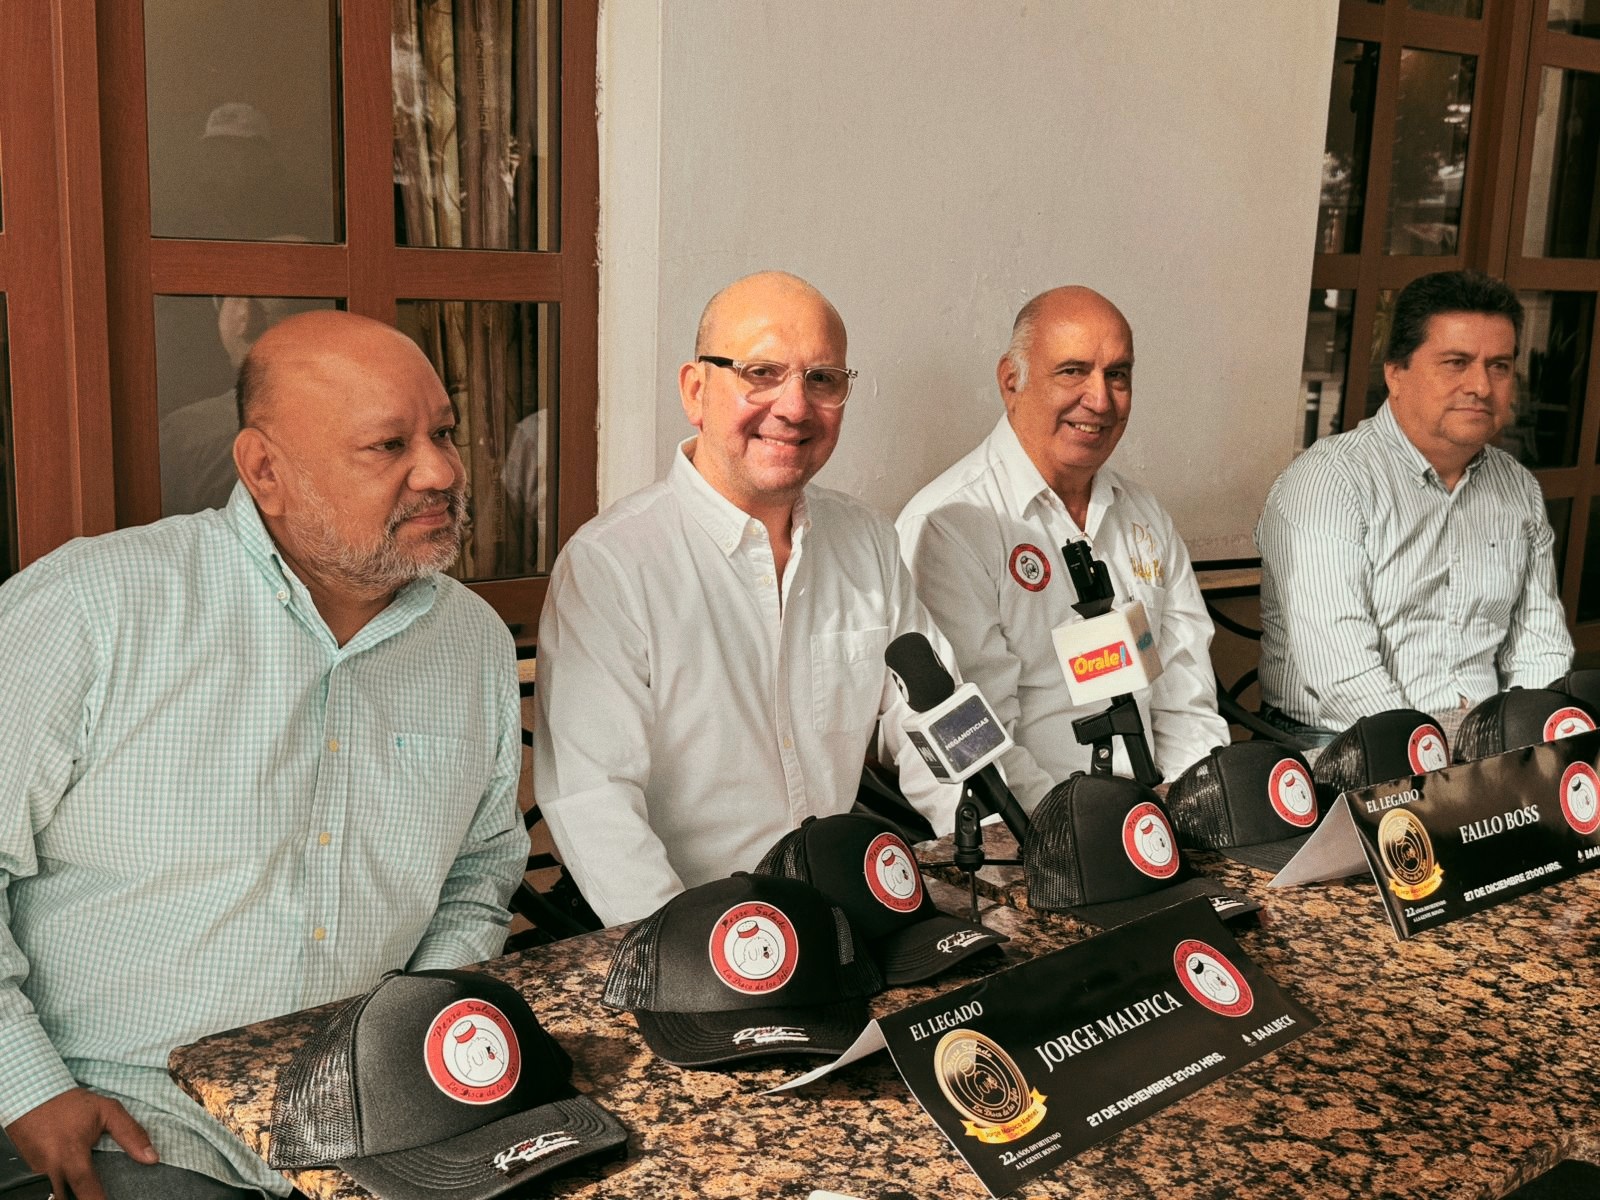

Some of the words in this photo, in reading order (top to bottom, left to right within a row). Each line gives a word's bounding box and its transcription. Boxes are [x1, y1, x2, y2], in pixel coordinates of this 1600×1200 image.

[944, 717, 990, 752] MEGANOTICIAS
[1366, 800, 1379, 814] EL
[1379, 788, 1419, 810] LEGADO
[1459, 815, 1503, 844] FALLO
[1504, 804, 1541, 830] BOSS
[1463, 890, 1476, 902] 27
[1473, 886, 1487, 898] DE
[1484, 872, 1527, 896] DICIEMBRE
[1543, 861, 1563, 874] HRS.
[433, 1010, 462, 1038] Perro
[909, 1022, 929, 1042] EL
[927, 1000, 984, 1035] LEGADO
[1034, 1023, 1104, 1073] JORGE
[1096, 990, 1184, 1040] MALPICA
[1251, 1014, 1297, 1041] BAALBECK
[1086, 1112, 1103, 1128] 27
[1100, 1104, 1121, 1120] DE
[1117, 1075, 1177, 1112] DICIEMBRE
[1173, 1062, 1203, 1083] 21:00
[1199, 1051, 1227, 1070] HRS.
[998, 1151, 1018, 1166] 22
